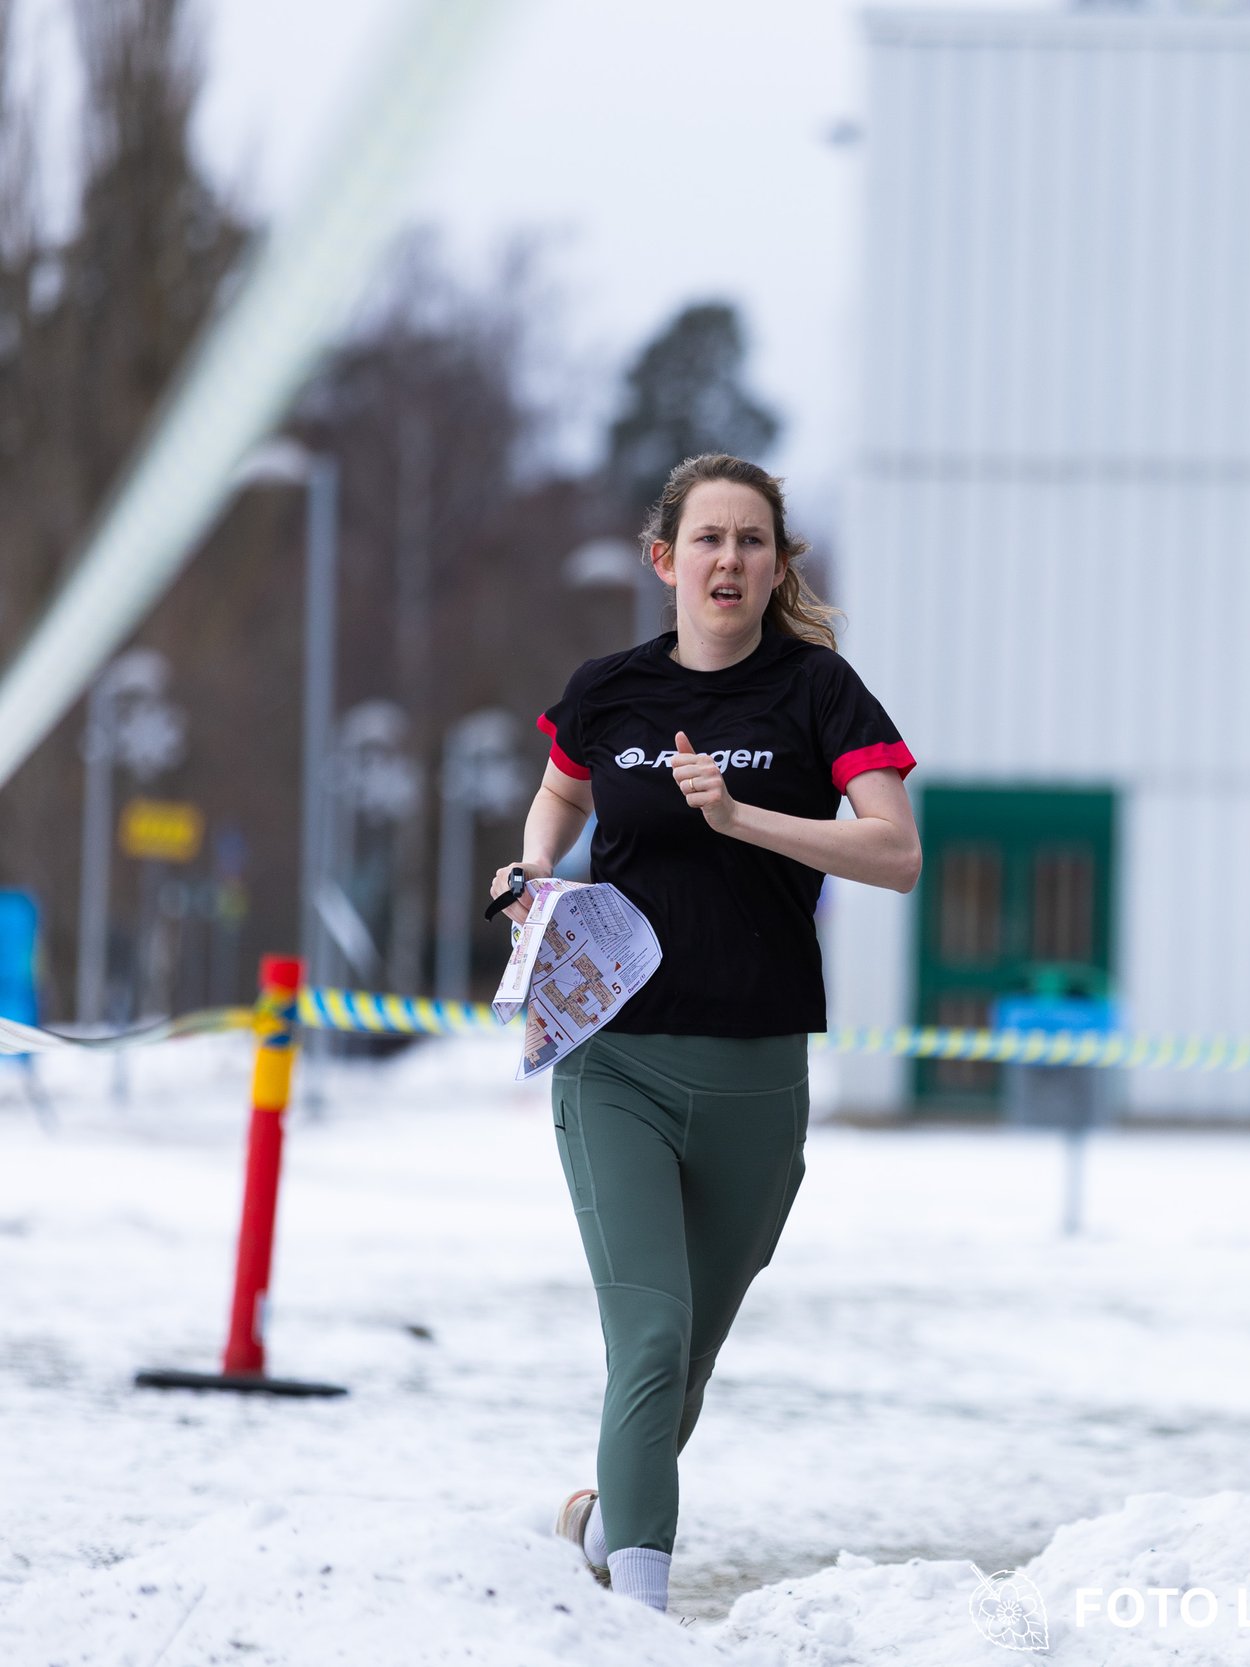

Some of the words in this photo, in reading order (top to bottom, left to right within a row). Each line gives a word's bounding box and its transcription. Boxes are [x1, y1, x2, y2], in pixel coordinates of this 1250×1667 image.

[566, 930, 576, 941] 6
[612, 982, 622, 995] 5
[554, 1031, 563, 1040] 1
